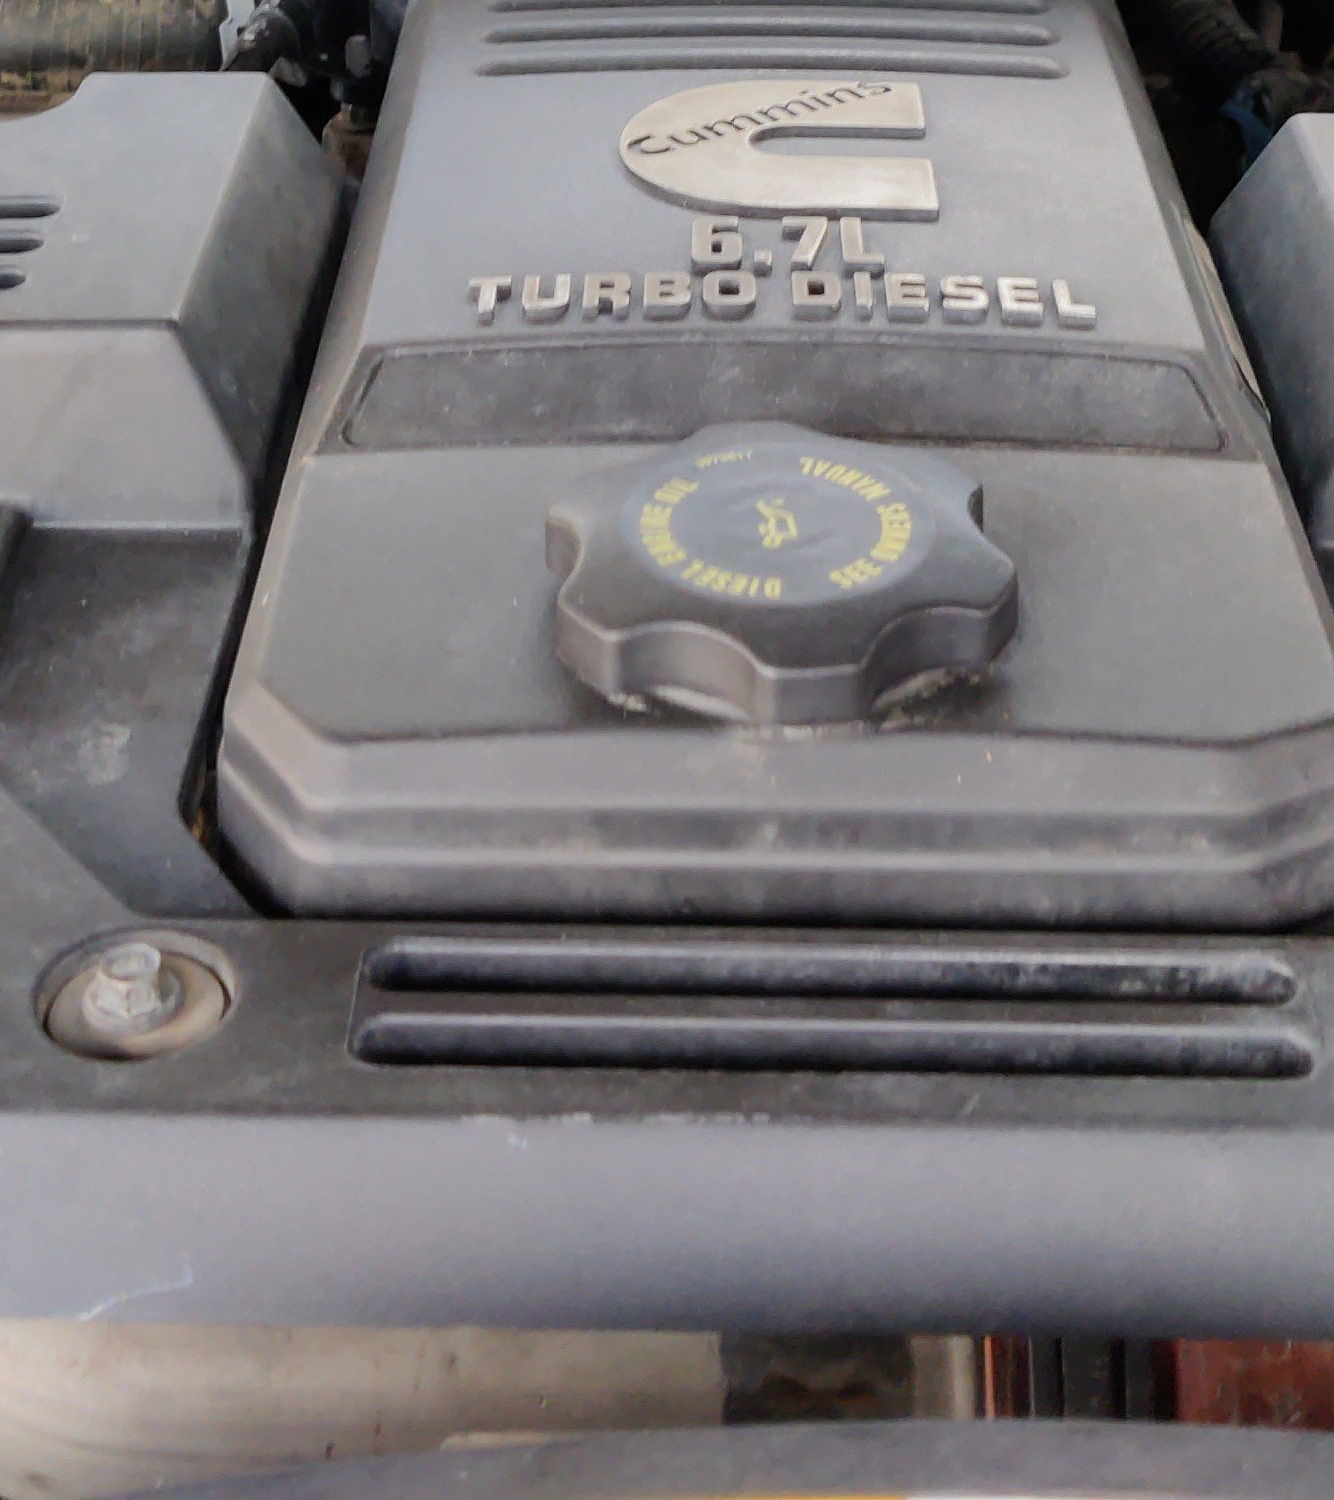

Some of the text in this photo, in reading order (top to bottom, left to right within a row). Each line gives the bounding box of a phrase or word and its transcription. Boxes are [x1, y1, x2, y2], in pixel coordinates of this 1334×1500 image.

[691, 218, 885, 274] 6.7L
[468, 271, 1098, 330] TURBO DIESEL
[802, 457, 891, 500] MANUAL
